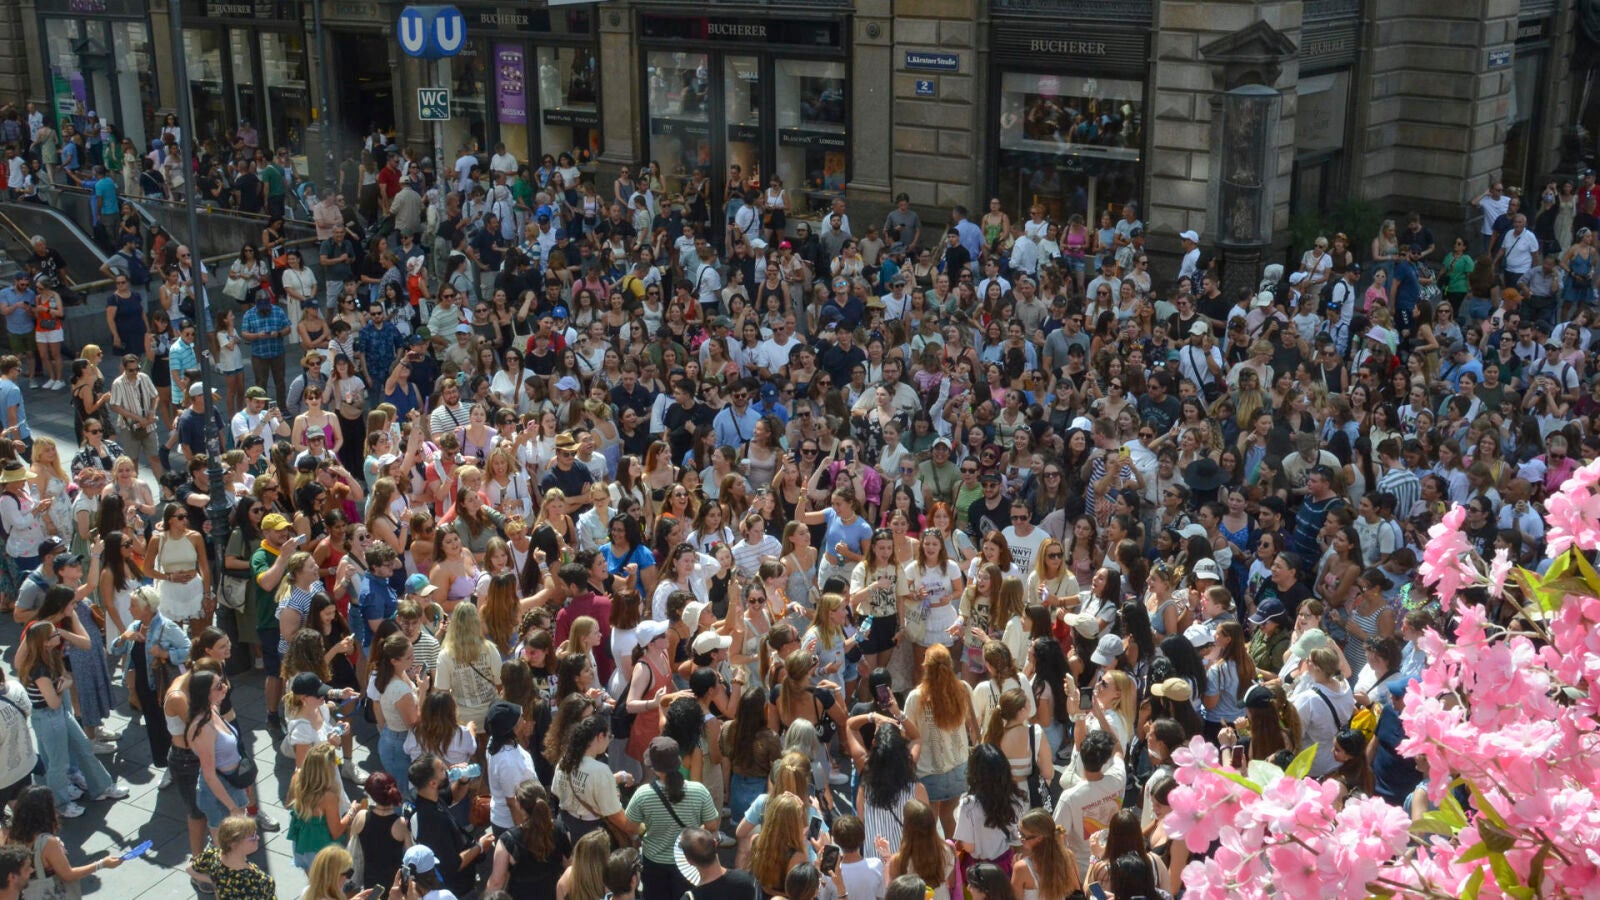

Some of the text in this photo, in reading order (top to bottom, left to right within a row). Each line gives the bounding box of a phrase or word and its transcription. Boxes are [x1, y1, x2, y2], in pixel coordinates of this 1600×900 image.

[480, 13, 529, 25] BUCHERER
[402, 16, 424, 52] U
[436, 16, 461, 51] U
[707, 23, 767, 37] BUCHERER
[1031, 39, 1107, 56] BUCHERER
[921, 81, 929, 90] 2
[420, 91, 447, 106] WC
